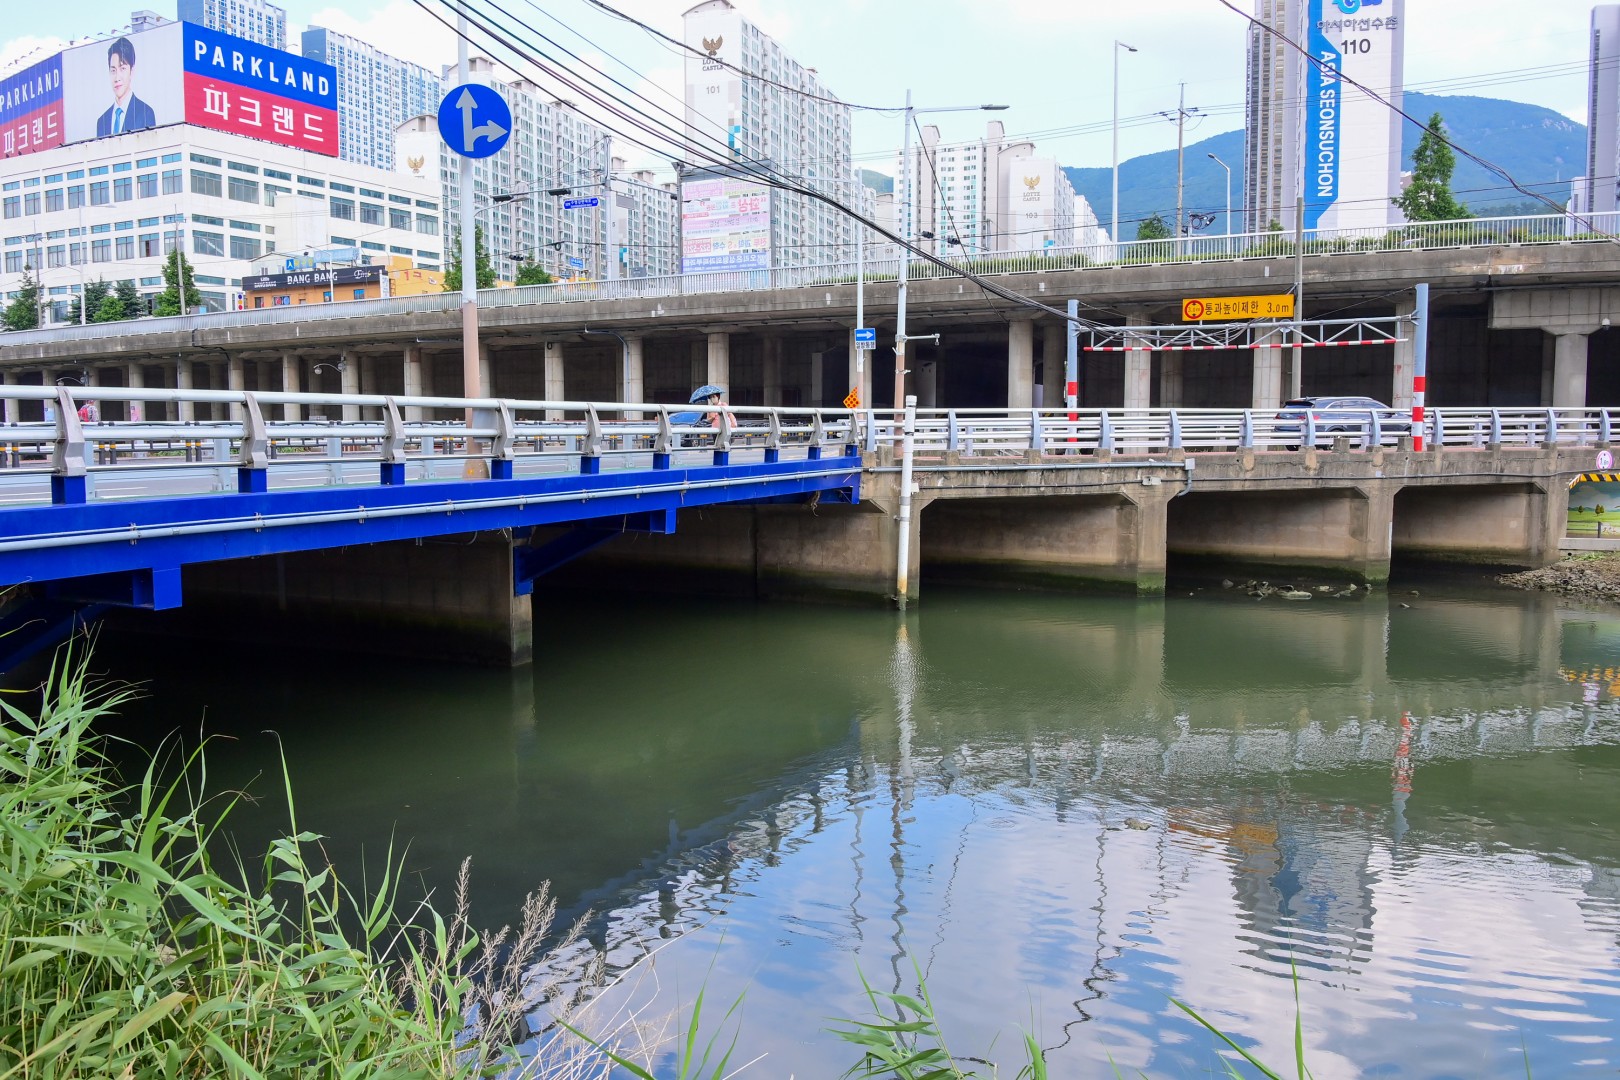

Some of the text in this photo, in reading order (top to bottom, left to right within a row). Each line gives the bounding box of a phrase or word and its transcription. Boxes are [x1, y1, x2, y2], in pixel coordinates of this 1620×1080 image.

[1317, 16, 1398, 33] 아시아선수촌
[1341, 38, 1371, 54] 110
[194, 40, 329, 96] PARKLAND
[0, 68, 60, 112] PARKLAND
[706, 85, 720, 94] 101
[203, 87, 324, 142] 파크랜드
[1317, 51, 1336, 197] ASIA SEONSUCHON
[4, 111, 58, 154] 파크랜드
[287, 271, 338, 285] BANG BANG
[1205, 300, 1289, 316] 통과높이제한 3.0m
